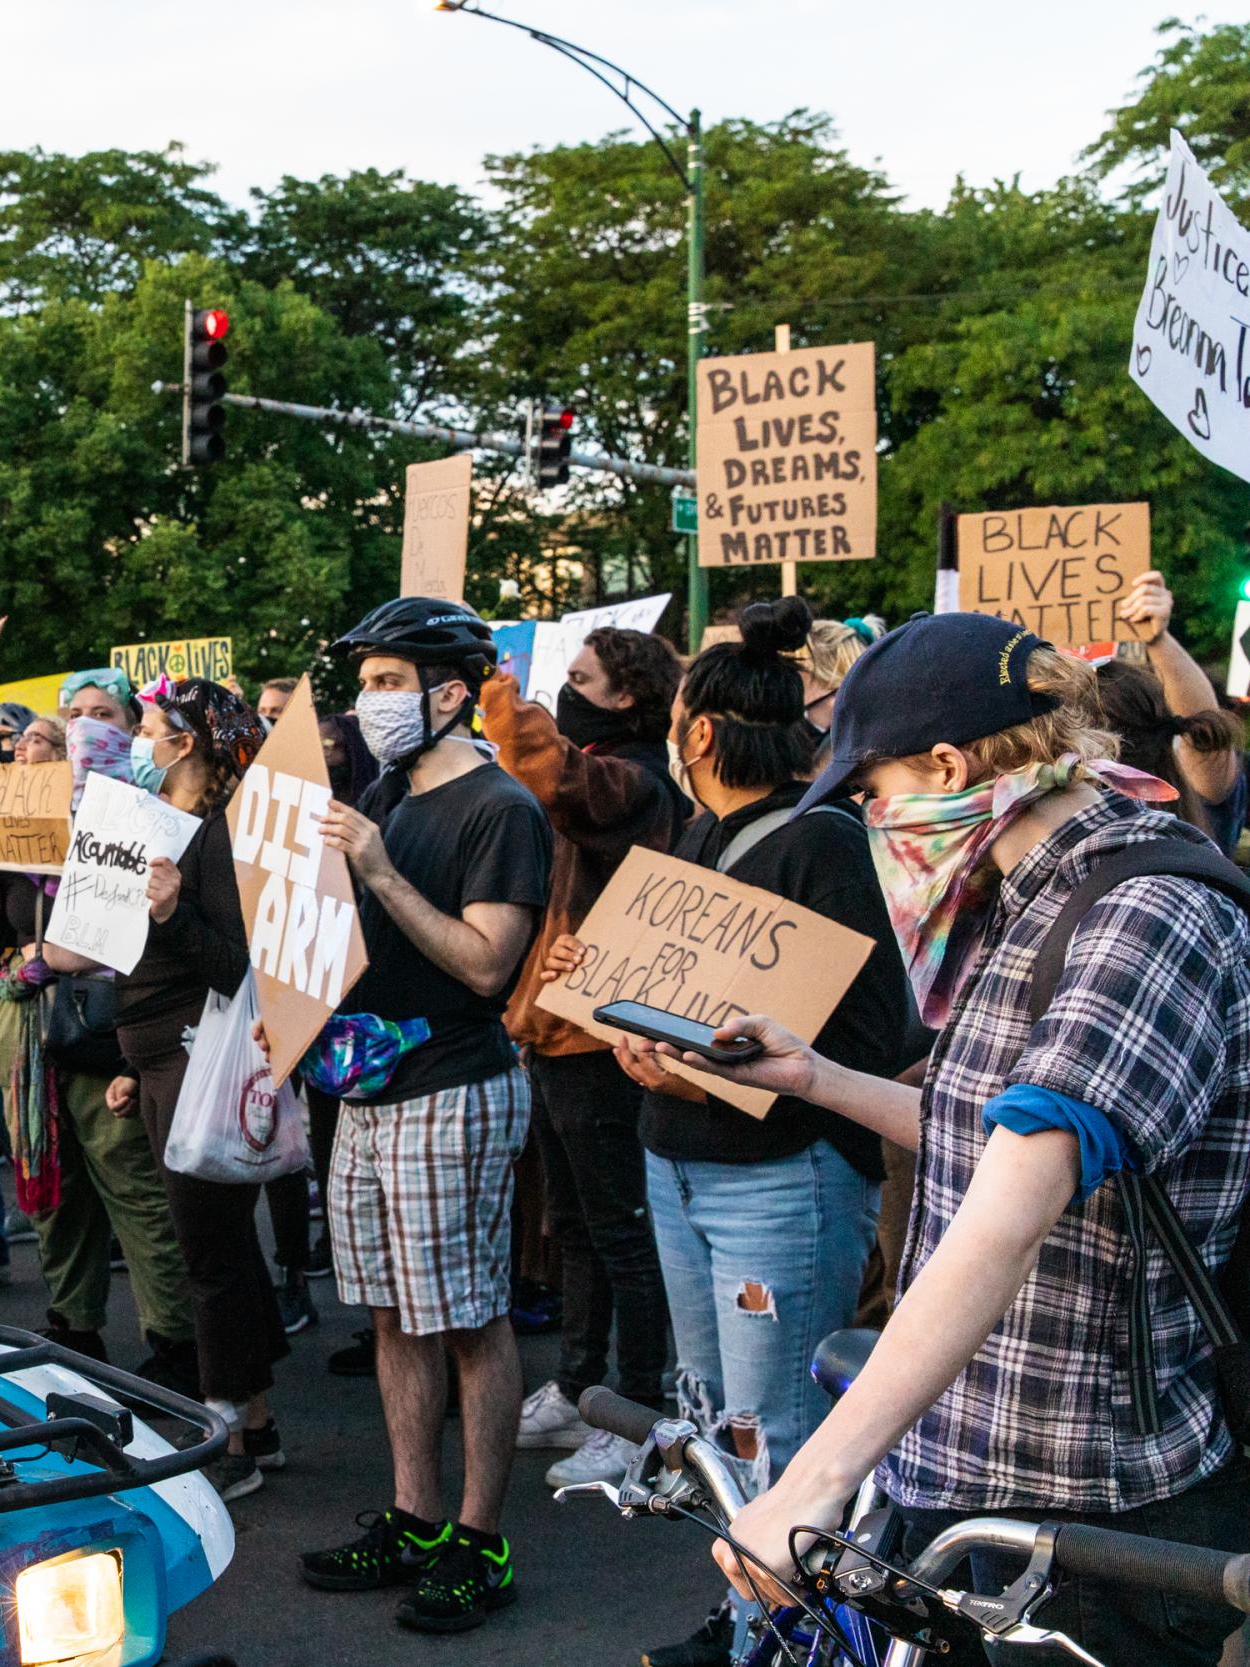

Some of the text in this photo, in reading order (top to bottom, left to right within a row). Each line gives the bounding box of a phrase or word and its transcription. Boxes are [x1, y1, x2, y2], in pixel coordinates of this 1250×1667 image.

[1167, 161, 1249, 297] Justice
[707, 359, 846, 415] BLACK
[733, 410, 845, 452] LIVES,
[723, 451, 865, 489] DREAMS,
[705, 492, 723, 519] &
[728, 492, 847, 526] FUTURES
[982, 510, 1123, 553] BLACK
[720, 525, 852, 563] MATTER
[978, 554, 1124, 604] LIVES
[973, 597, 1141, 643] ATTER
[114, 640, 230, 685] BLACK LIVES
[233, 763, 333, 891] DIS
[250, 872, 355, 1010] ARM
[625, 872, 797, 971] KOREANS
[564, 944, 666, 1006] BLACK
[651, 942, 698, 984] FOR
